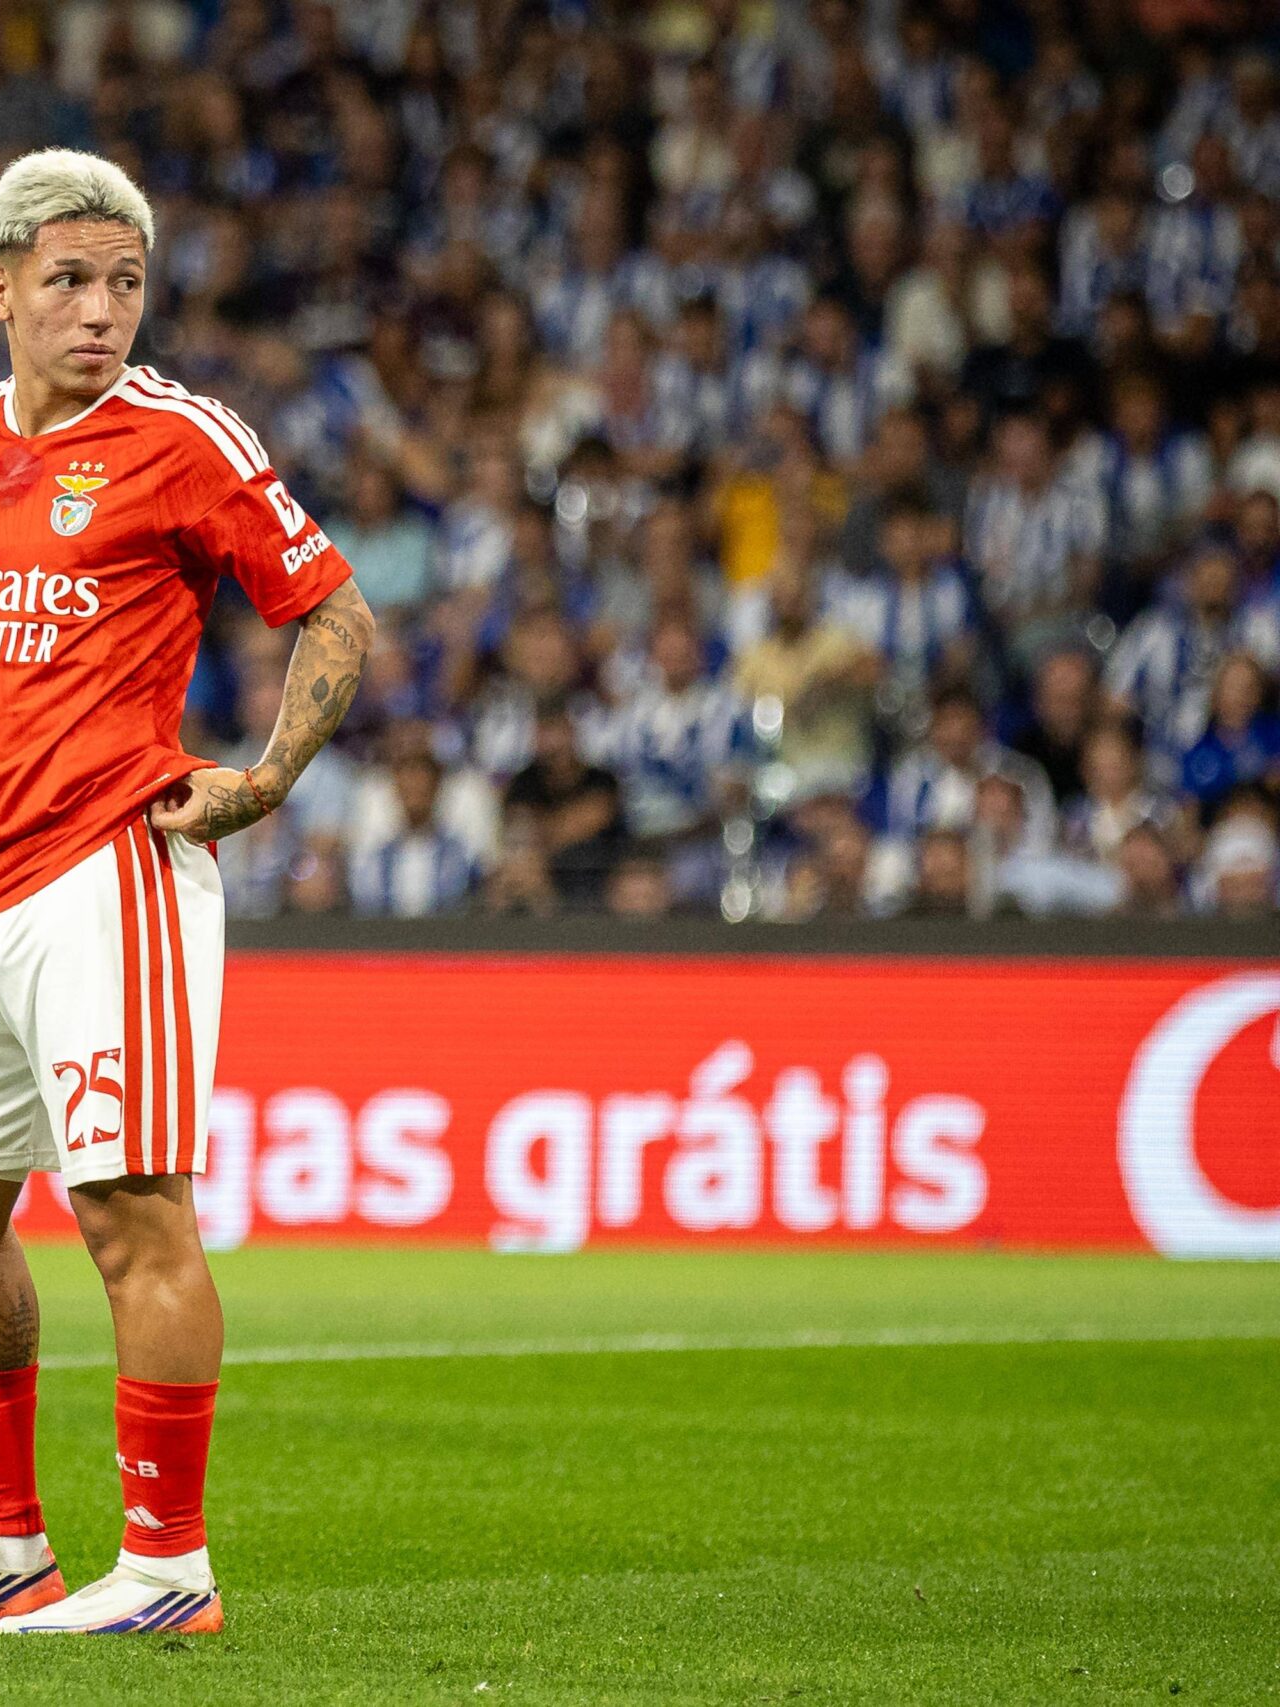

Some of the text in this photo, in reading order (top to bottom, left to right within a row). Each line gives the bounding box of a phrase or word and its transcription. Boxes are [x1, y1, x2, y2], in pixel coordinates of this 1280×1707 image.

[281, 529, 332, 576] Beta
[52, 1047, 124, 1152] 25
[484, 1039, 989, 1254] grátis
